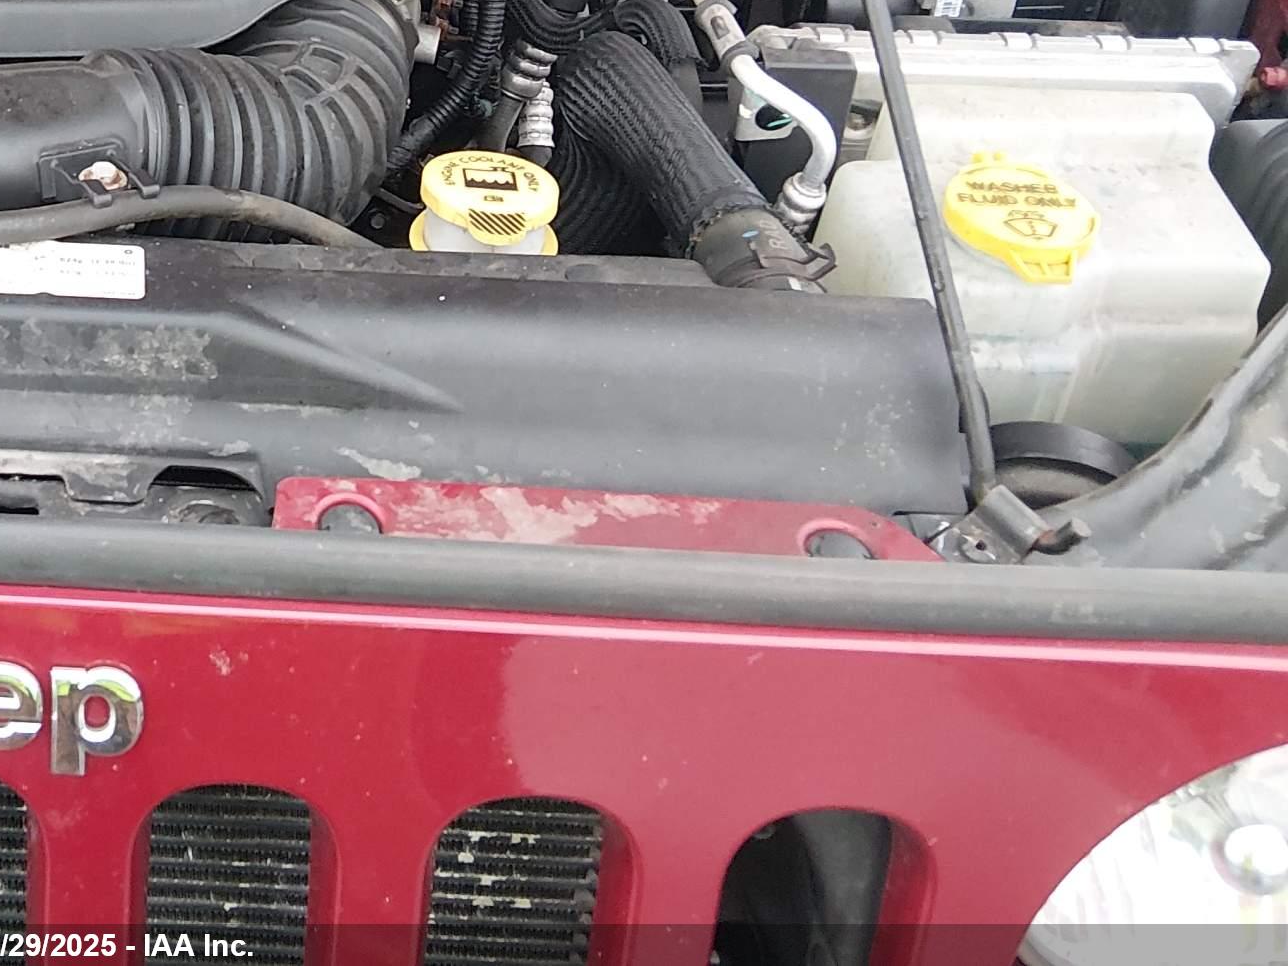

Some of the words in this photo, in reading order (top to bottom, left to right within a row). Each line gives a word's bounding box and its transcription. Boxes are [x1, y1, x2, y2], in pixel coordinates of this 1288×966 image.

[459, 155, 526, 171] COOLANT
[523, 171, 540, 192] ONLY
[966, 181, 1059, 195] WASHER
[957, 192, 1018, 205] FLUID
[1024, 196, 1077, 208] ONLY
